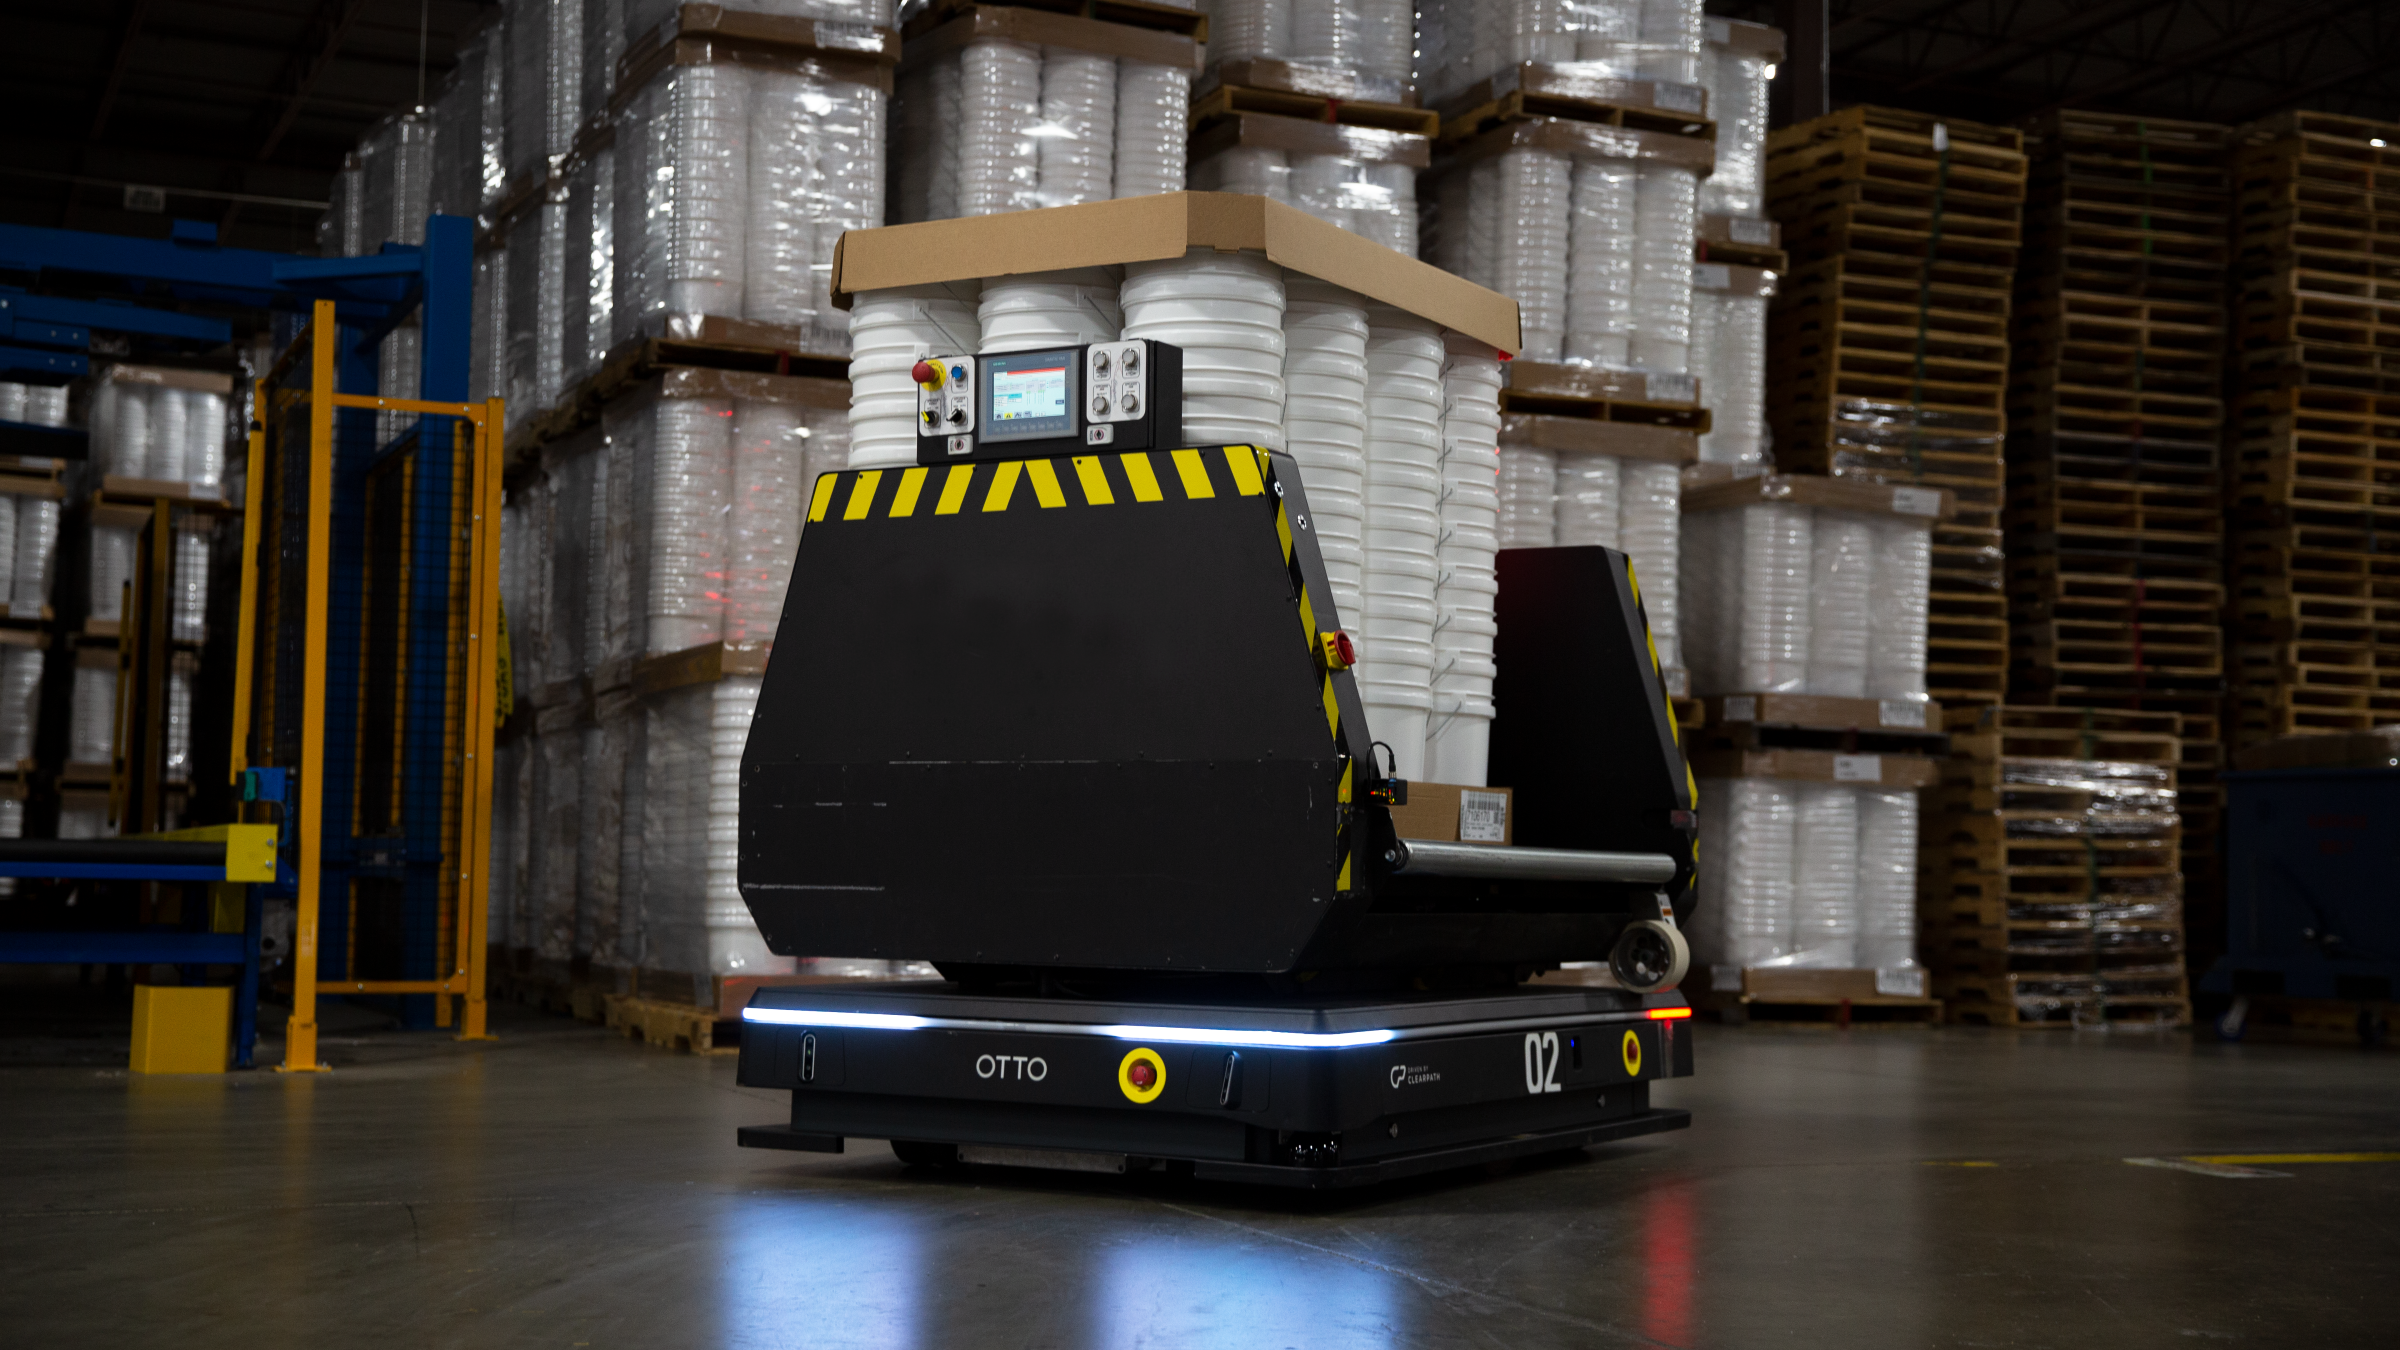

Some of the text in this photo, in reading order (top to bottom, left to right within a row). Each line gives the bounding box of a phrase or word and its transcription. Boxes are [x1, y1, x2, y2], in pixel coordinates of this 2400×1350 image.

[976, 1054, 1047, 1081] OTTO
[1525, 1031, 1562, 1094] 02
[1407, 1073, 1440, 1084] CLEARPATH
